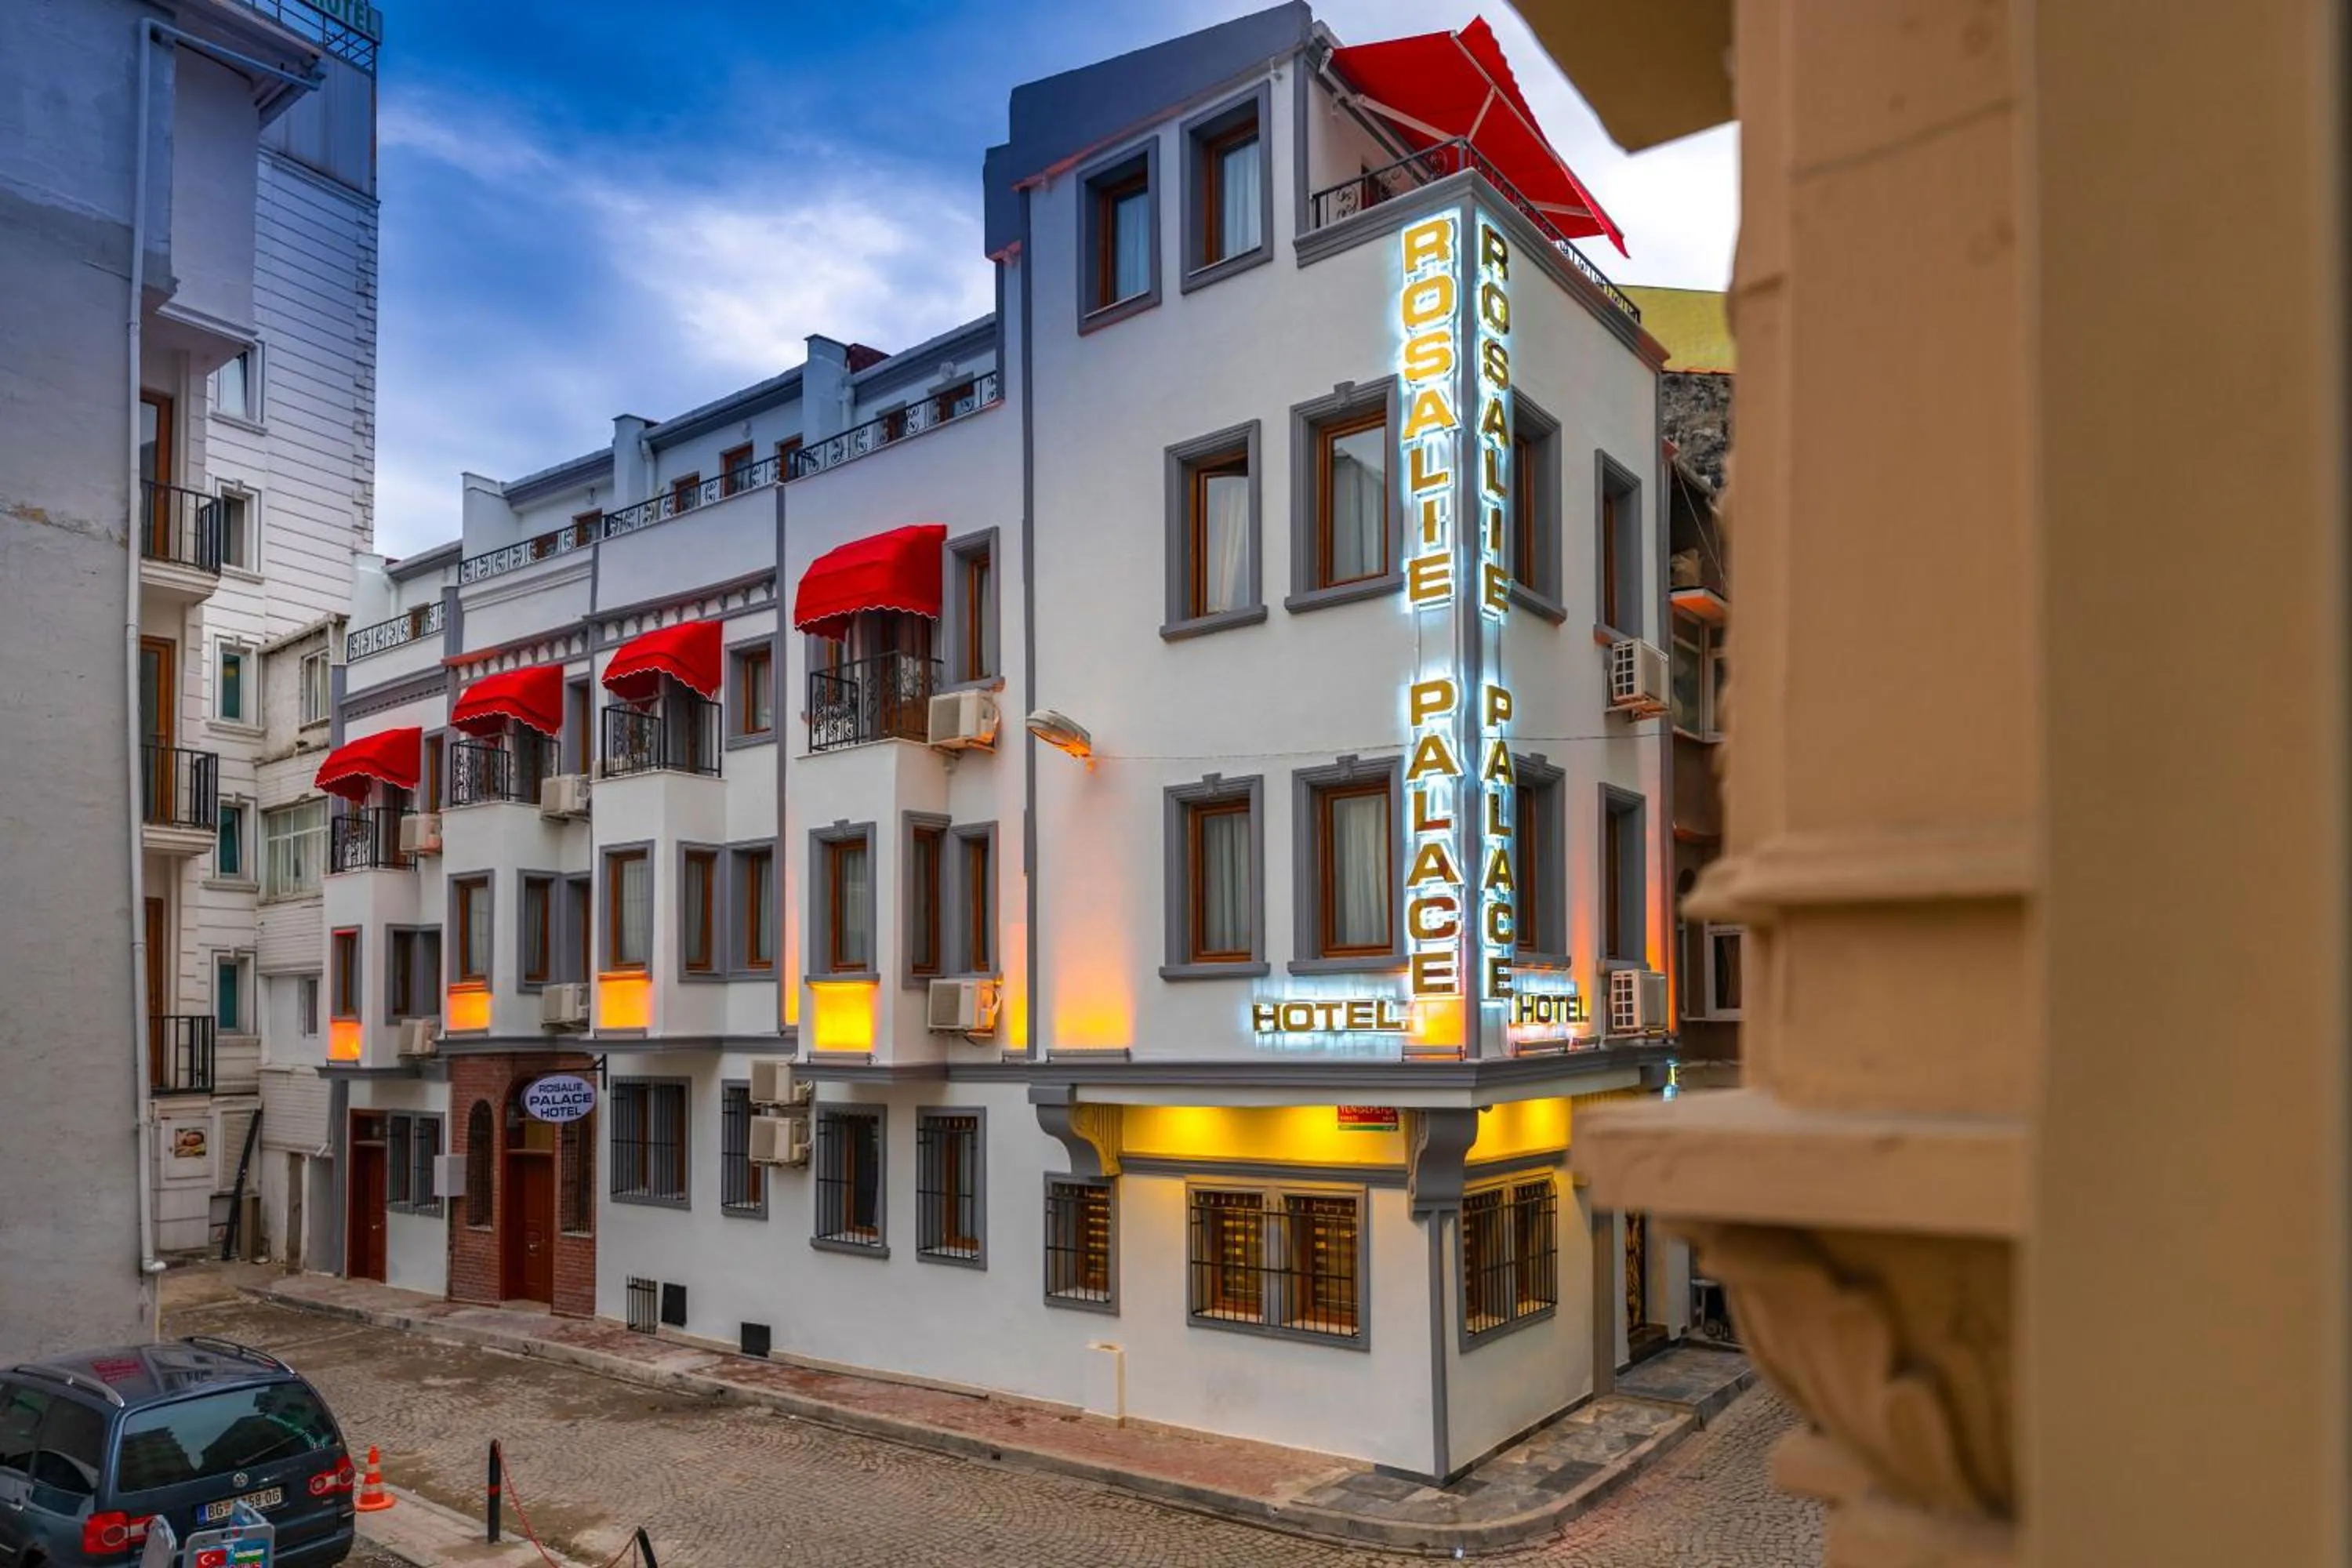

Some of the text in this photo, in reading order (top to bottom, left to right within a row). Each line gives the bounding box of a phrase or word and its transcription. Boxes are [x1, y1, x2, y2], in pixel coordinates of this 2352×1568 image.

[1403, 218, 1460, 994] ROSALIE PALACE
[1481, 224, 1515, 998] ROSALIE PALACE
[1253, 1002, 1403, 1032] HOTEL
[1519, 994, 1590, 1023] HOTEL
[529, 1093, 593, 1106] PALACE
[540, 1107, 581, 1117] HOTEL
